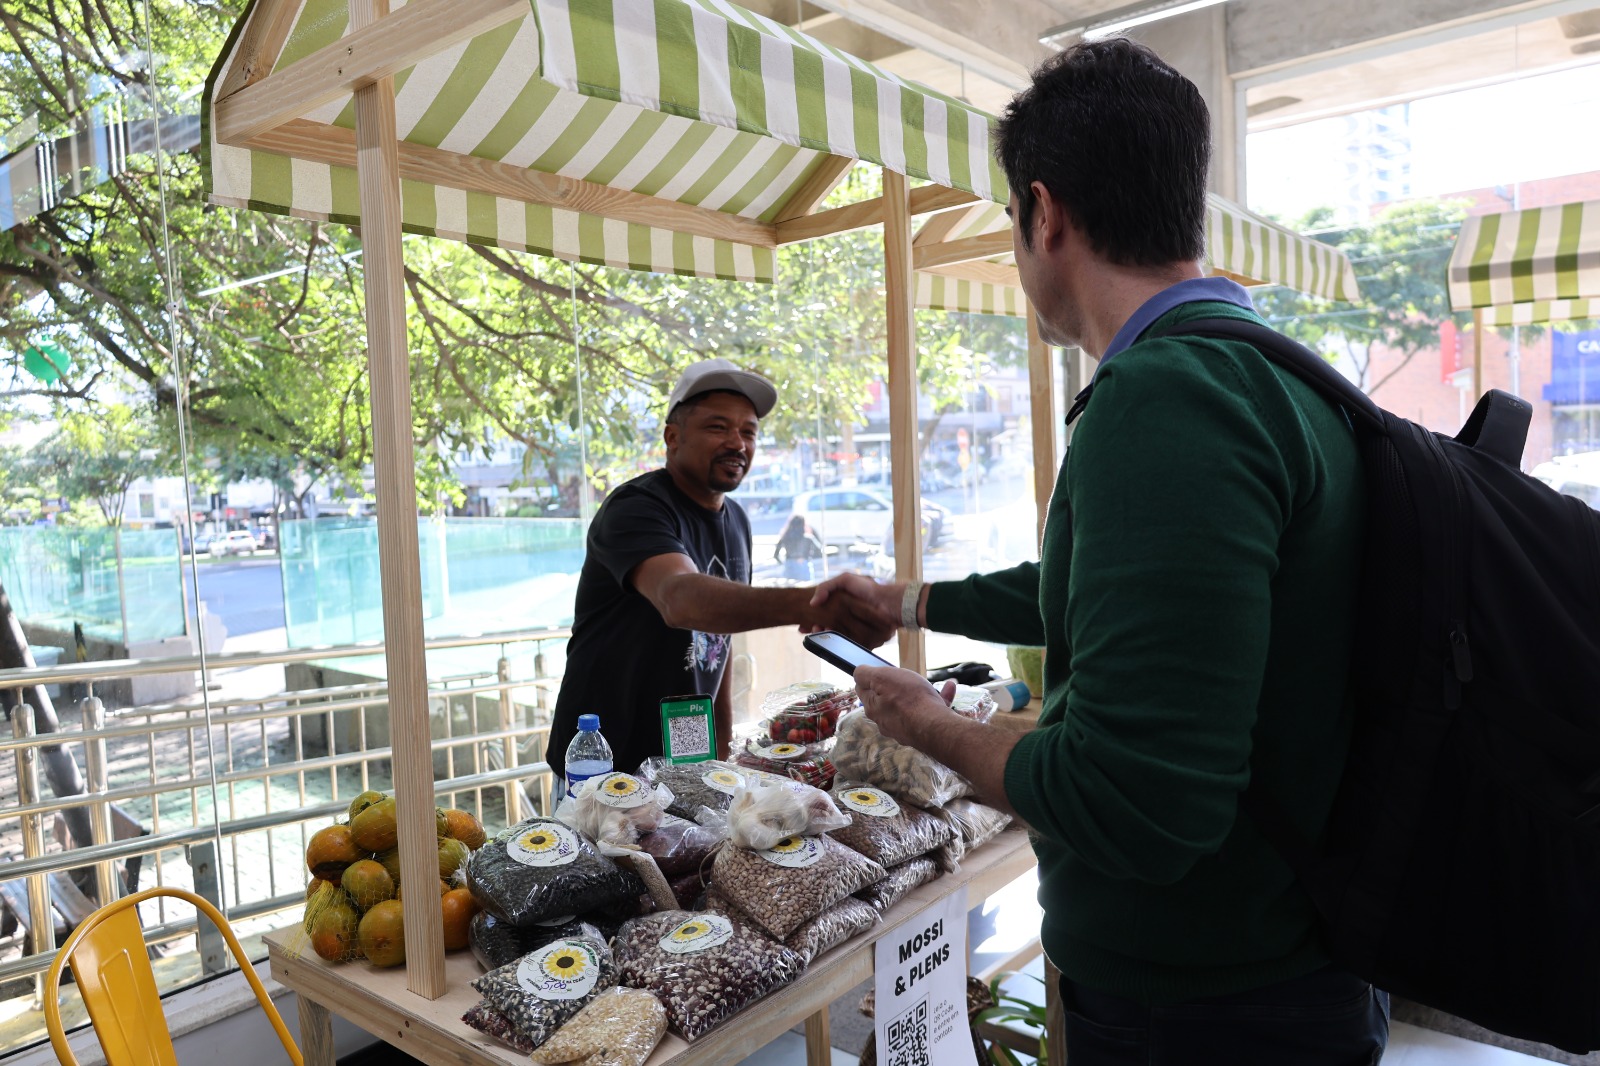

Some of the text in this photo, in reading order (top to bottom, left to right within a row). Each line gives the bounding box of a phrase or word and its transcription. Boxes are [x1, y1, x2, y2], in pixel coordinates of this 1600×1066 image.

[898, 918, 943, 964] MOSSI
[894, 943, 950, 996] & PLENS
